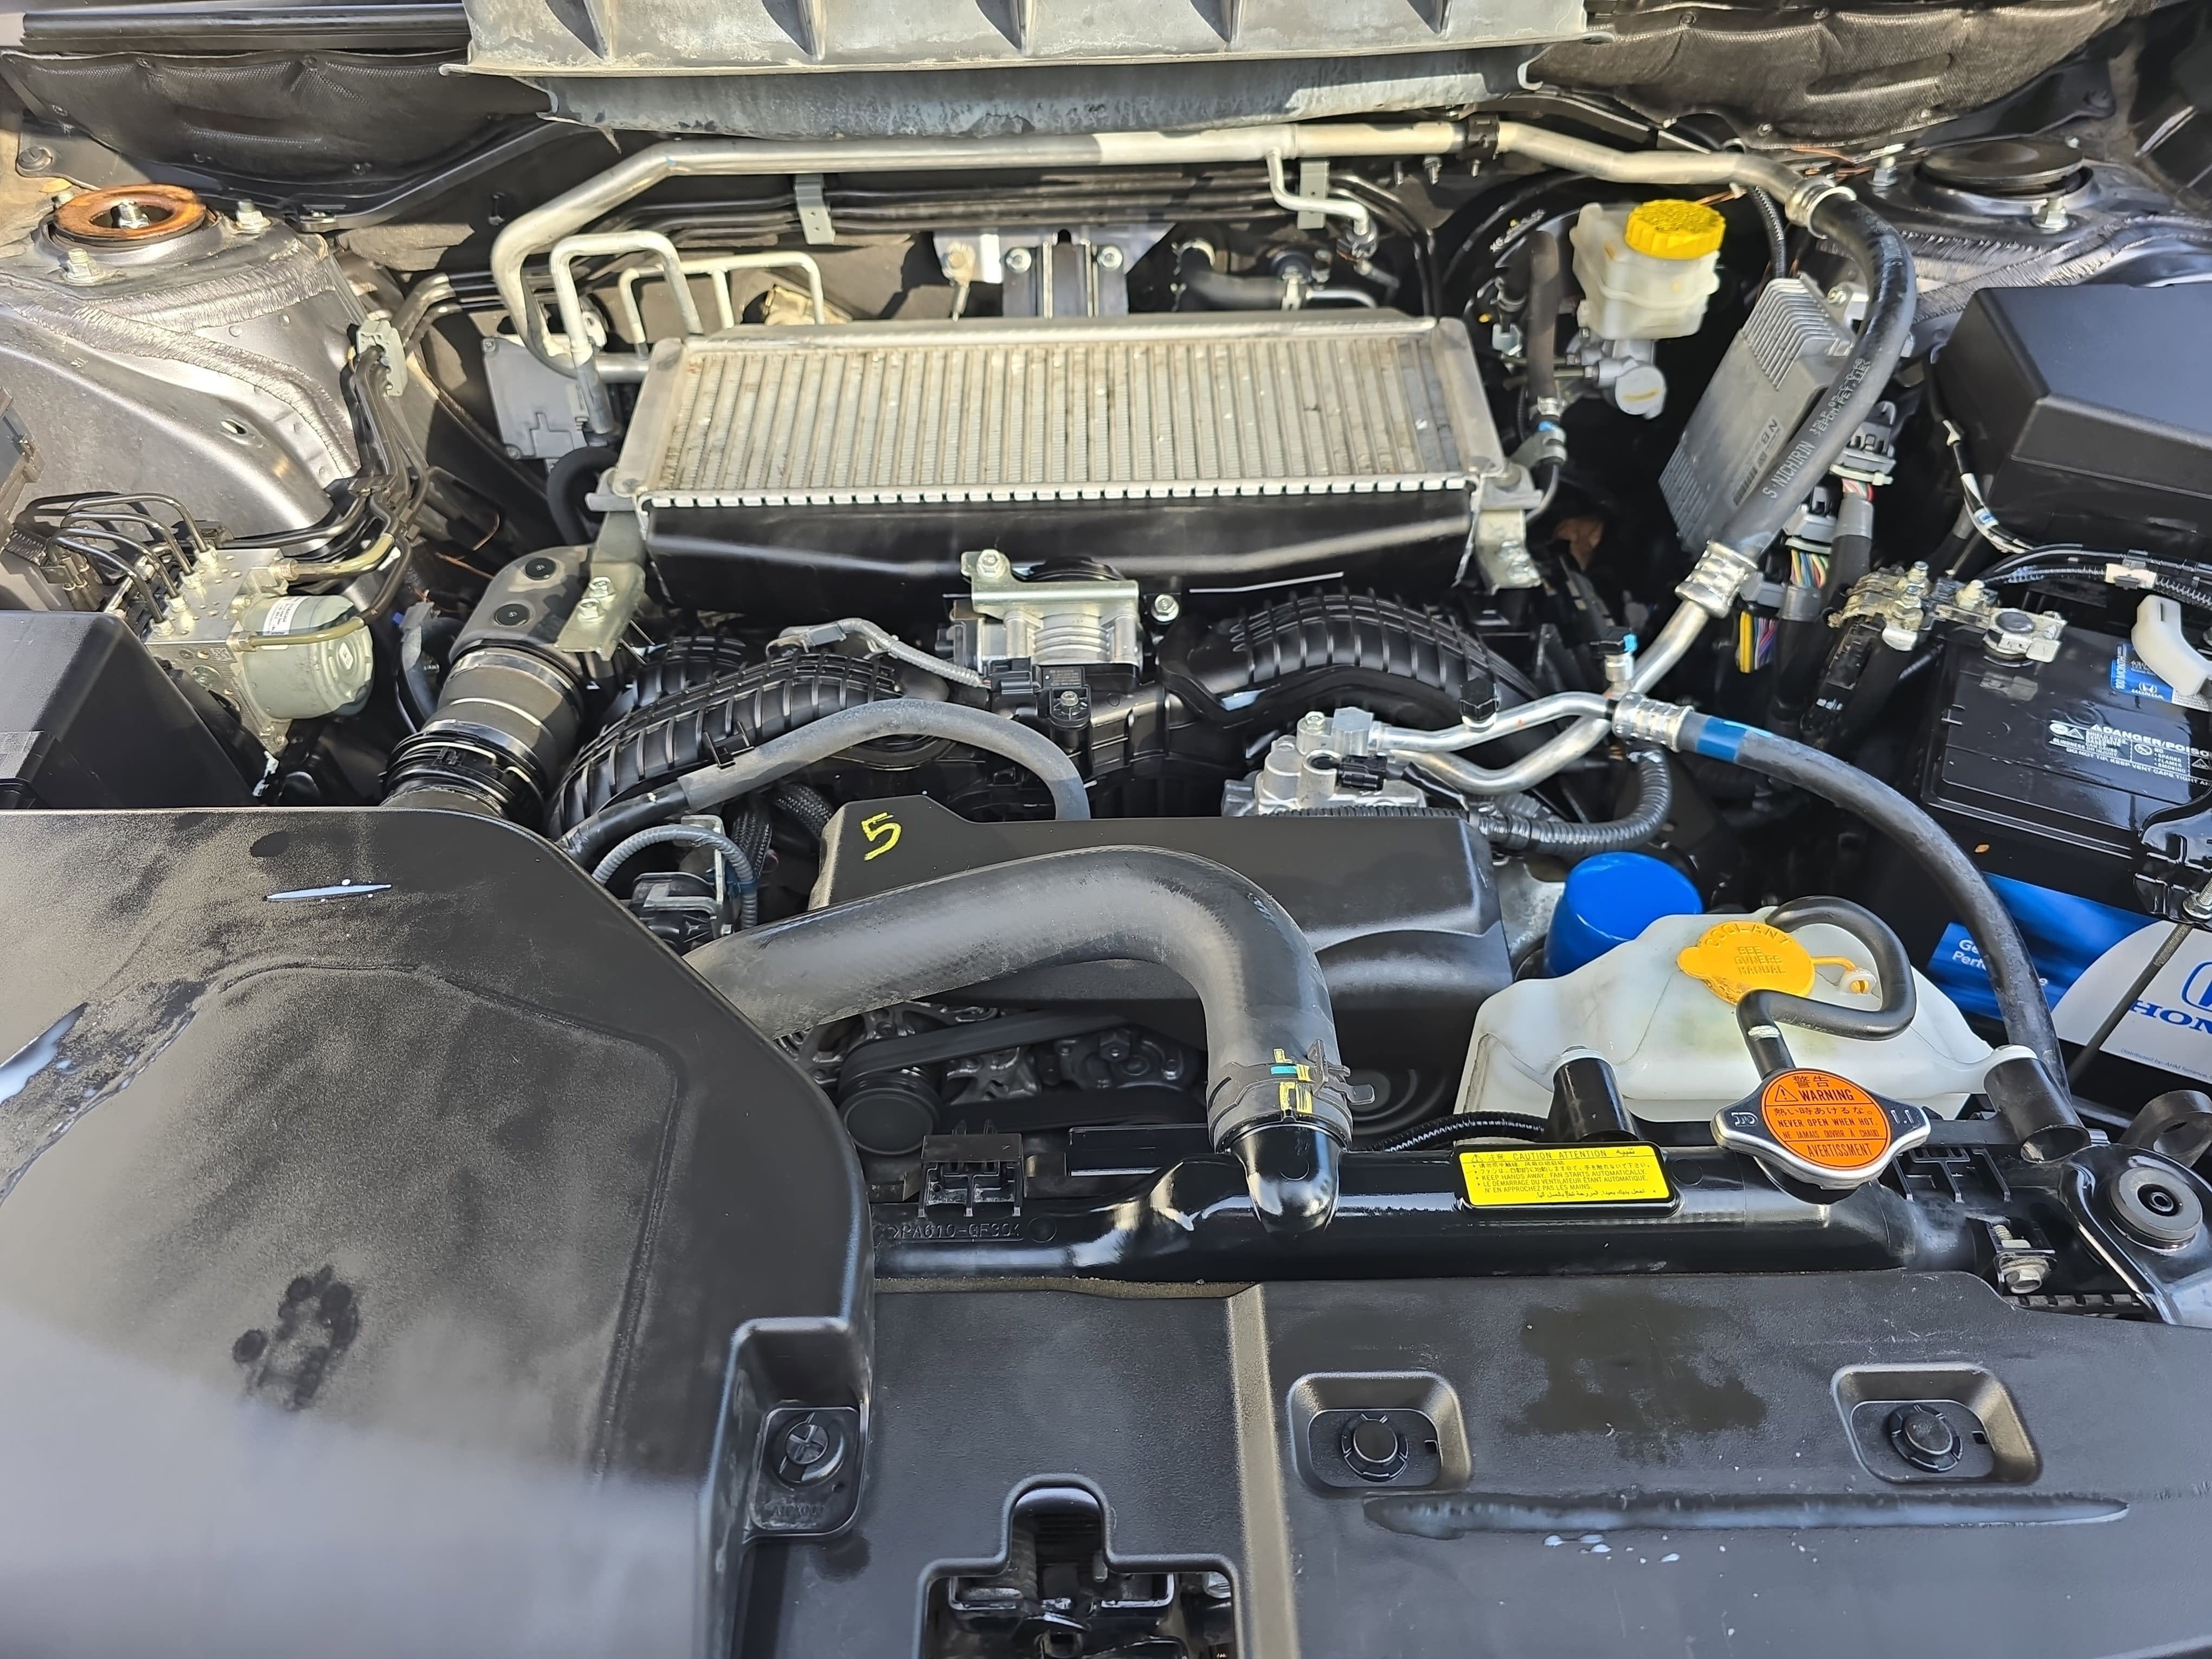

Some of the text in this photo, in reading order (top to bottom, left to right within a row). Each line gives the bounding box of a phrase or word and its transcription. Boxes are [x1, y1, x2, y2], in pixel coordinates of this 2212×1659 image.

[861, 812, 901, 861] 5
[1705, 923, 1792, 948] COOLANT
[1738, 965, 1786, 975] MANUAL
[1792, 1075, 1830, 1088] 警告
[1798, 1089, 1855, 1102] WARNING
[1777, 1117, 1878, 1127] NEVER OPEN WHEN HOT.
[1783, 1128, 1883, 1139] NE JAMAIS OUVRIR À CHAUD.
[1513, 1149, 1607, 1160] CAUTION ATTENTION
[1806, 1143, 1873, 1157] AVERTISSMENT
[1592, 1169, 1647, 1177] AUTOMATICALLY.
